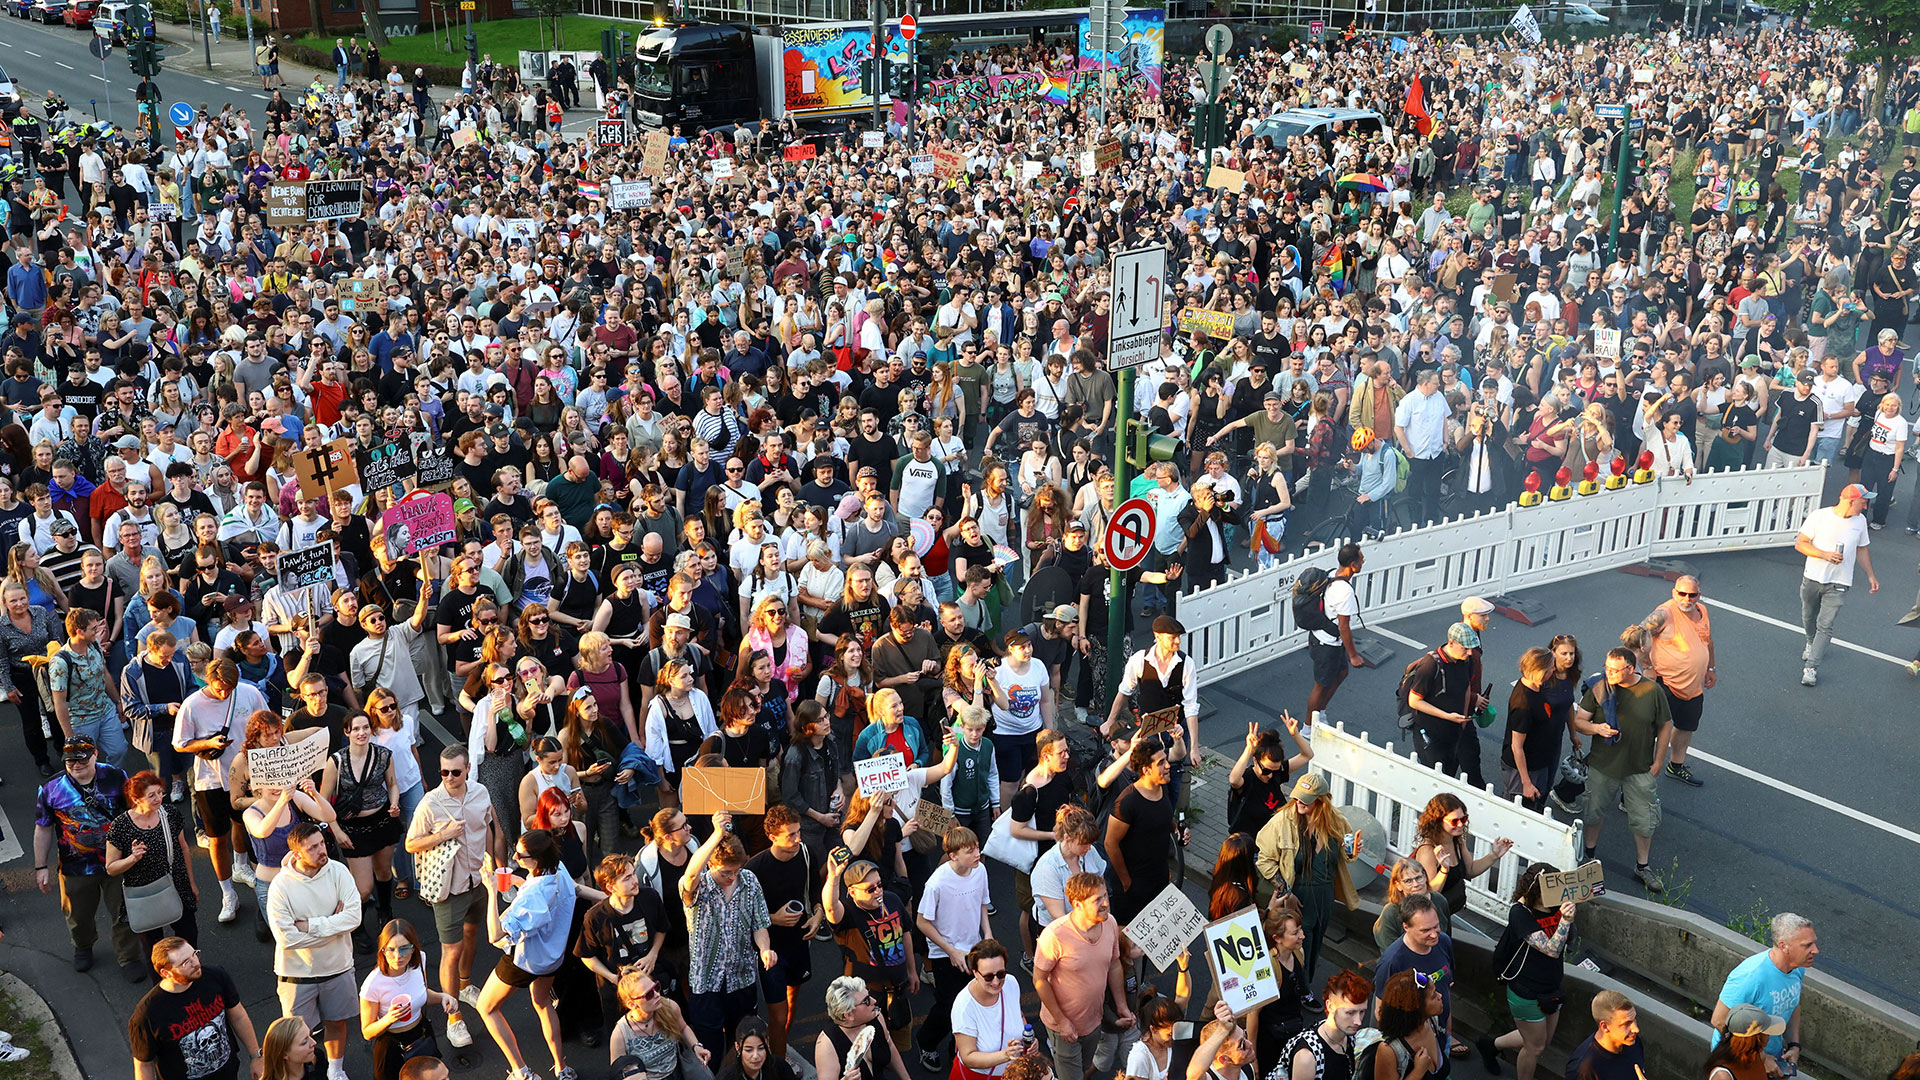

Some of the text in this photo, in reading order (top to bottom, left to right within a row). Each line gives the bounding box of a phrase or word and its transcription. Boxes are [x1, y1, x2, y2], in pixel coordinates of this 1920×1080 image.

[1598, 107, 1623, 116] Alfredstr.
[600, 125, 622, 135] FCK
[600, 135, 622, 144] AFD
[622, 184, 639, 192] FUCKED
[618, 199, 651, 207] GENERATION
[1596, 330, 1619, 341] BUNT
[1595, 344, 1618, 356] BRAUN
[1117, 351, 1145, 366] Vorsicht
[65, 395, 96, 404] HARDCORE
[910, 468, 933, 478] VANS
[415, 531, 454, 549] RACISM
[1279, 574, 1294, 587] BVS
[251, 752, 266, 761] Die
[268, 748, 287, 758] AfD
[289, 746, 299, 755] ist
[858, 755, 897, 769] FASCHISTEN
[861, 769, 899, 787] KEINE
[863, 780, 906, 795] ALTERNATIVE
[923, 818, 943, 830] OUT!
[1560, 884, 1590, 901] AFD
[1132, 915, 1154, 941] LEBE
[1163, 895, 1178, 911] DASS
[1145, 938, 1158, 953] DIE
[1170, 907, 1187, 926] WAS
[1155, 909, 1201, 967] DAGEGEN HÄTTE!
[1242, 983, 1255, 993] FCK
[1245, 991, 1257, 1000] AFD
